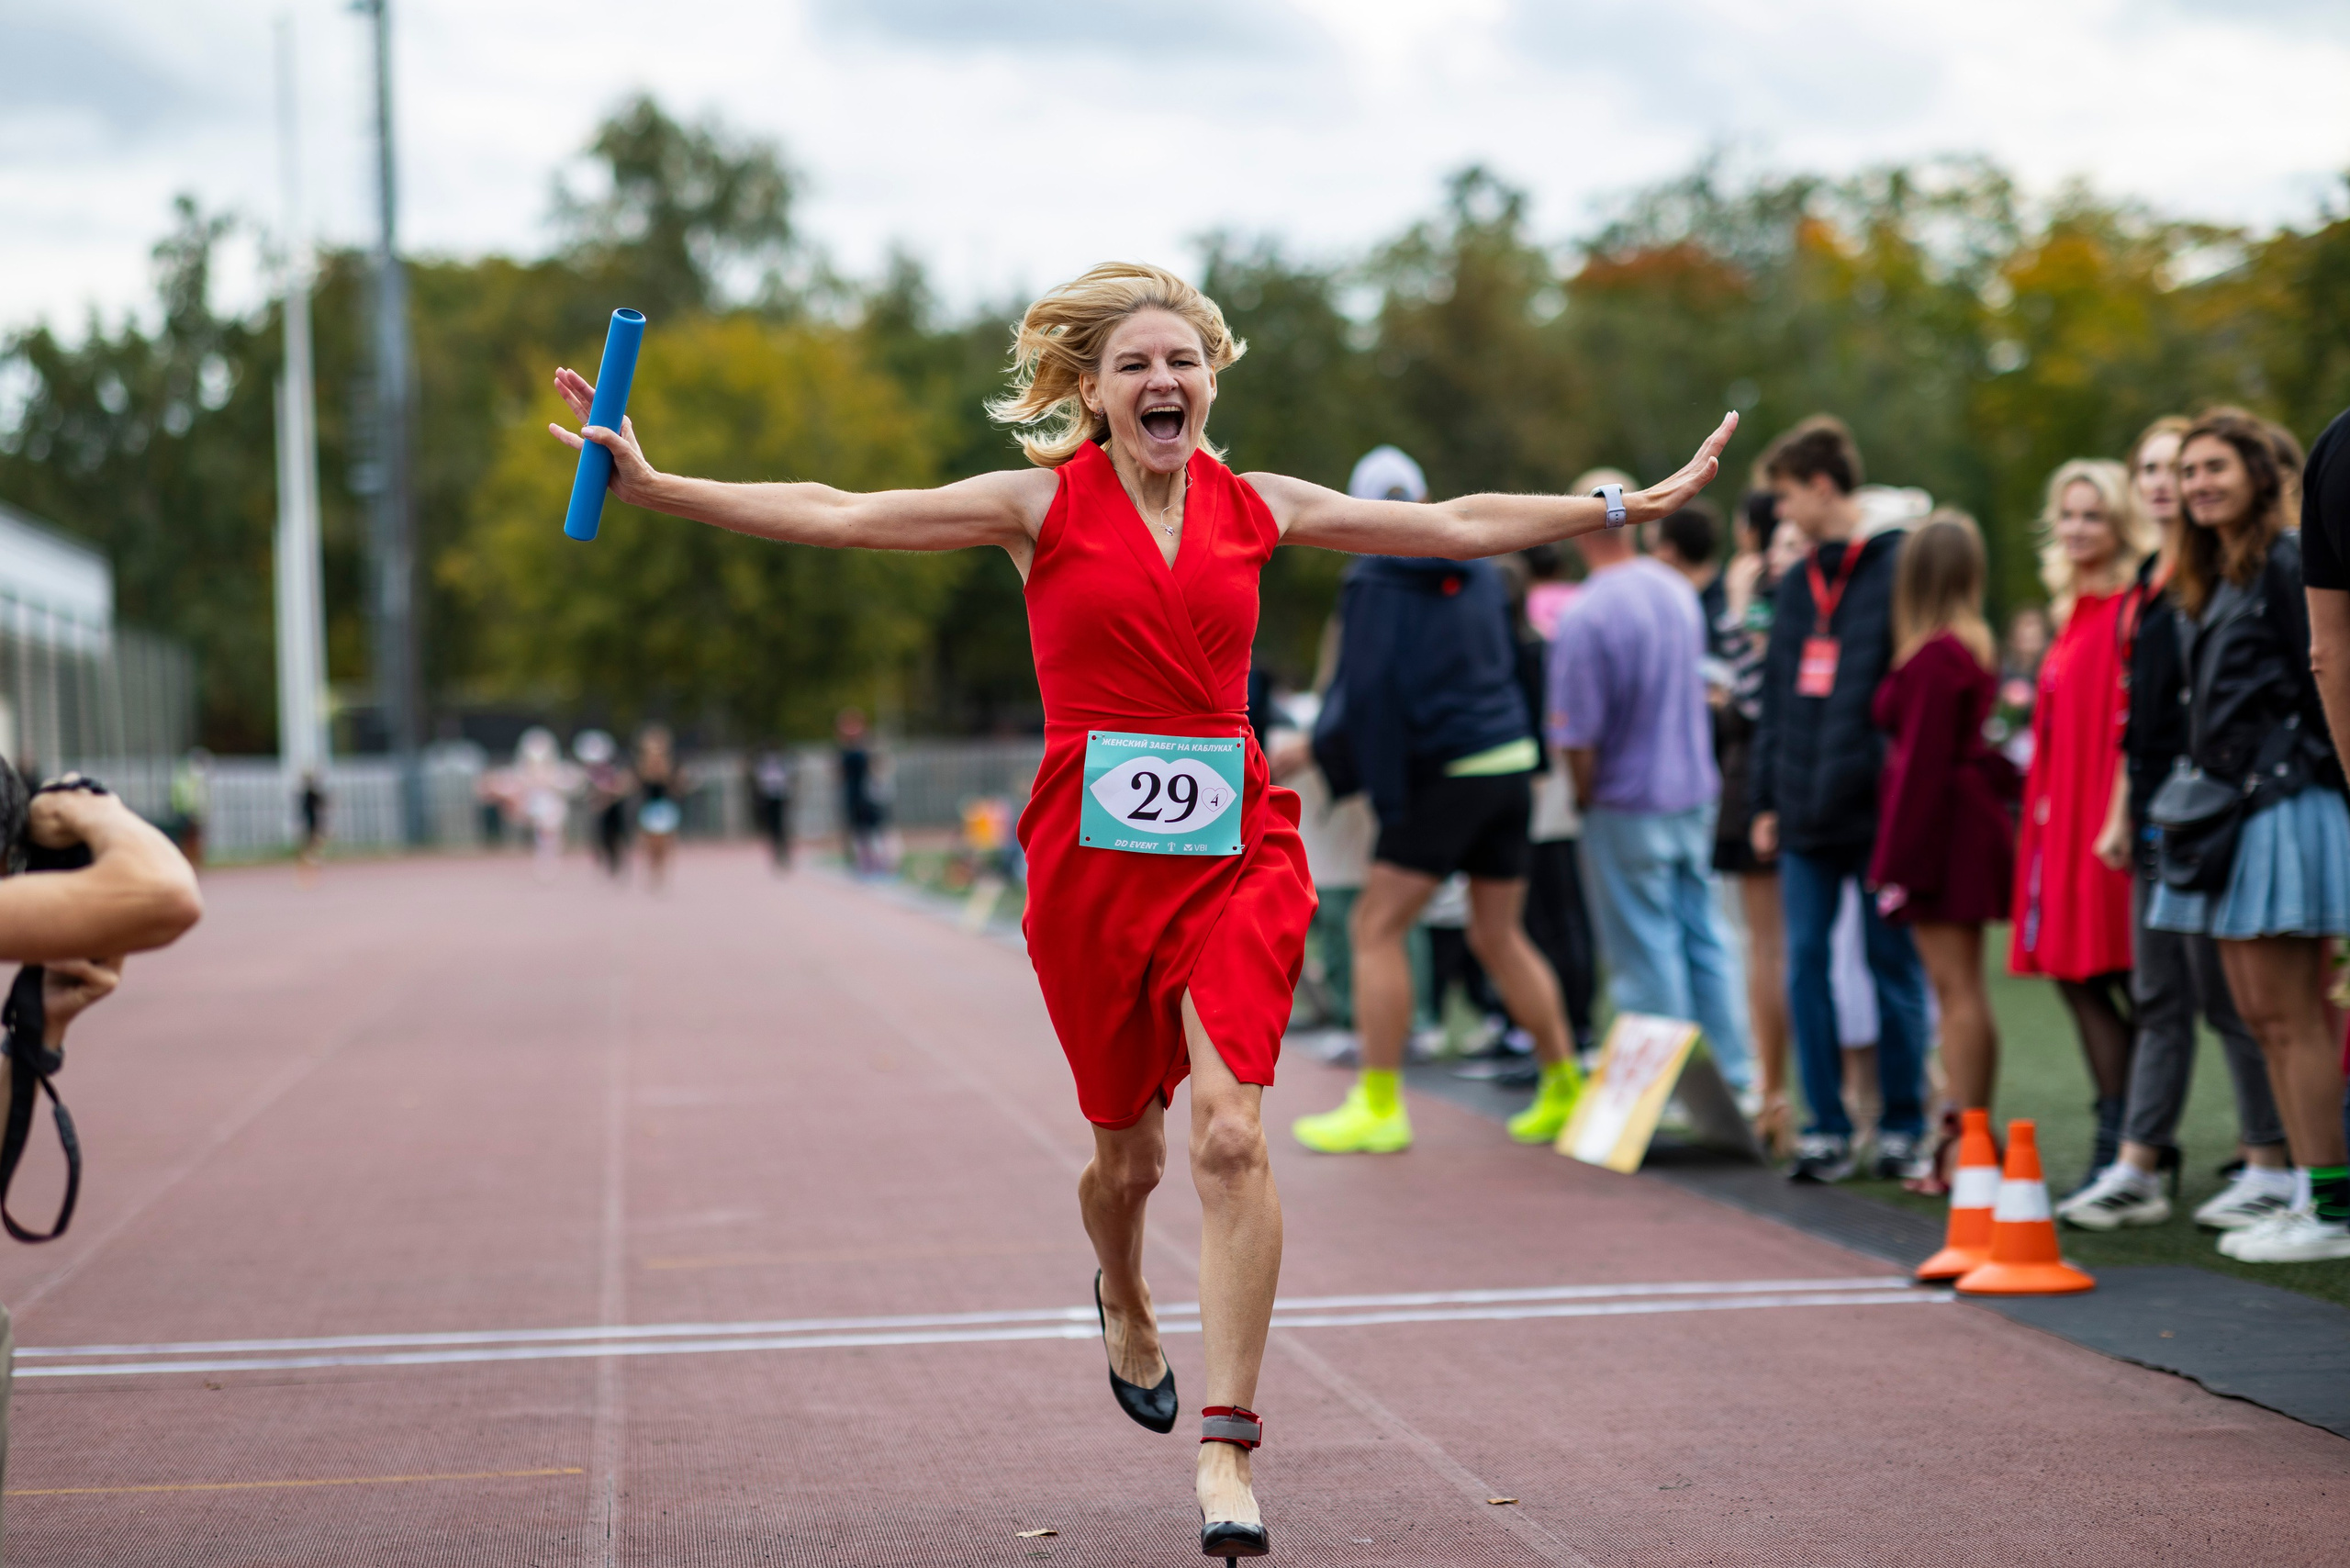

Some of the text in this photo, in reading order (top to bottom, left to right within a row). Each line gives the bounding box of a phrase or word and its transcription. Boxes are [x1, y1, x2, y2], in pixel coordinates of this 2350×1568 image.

[1102, 738, 1147, 748] ЖЕНСКИЙ
[1149, 742, 1176, 751] ЗАБЕГ
[1127, 771, 1198, 823] 29
[1114, 839, 1158, 850] DD EVENT
[1194, 844, 1207, 852] VBI
